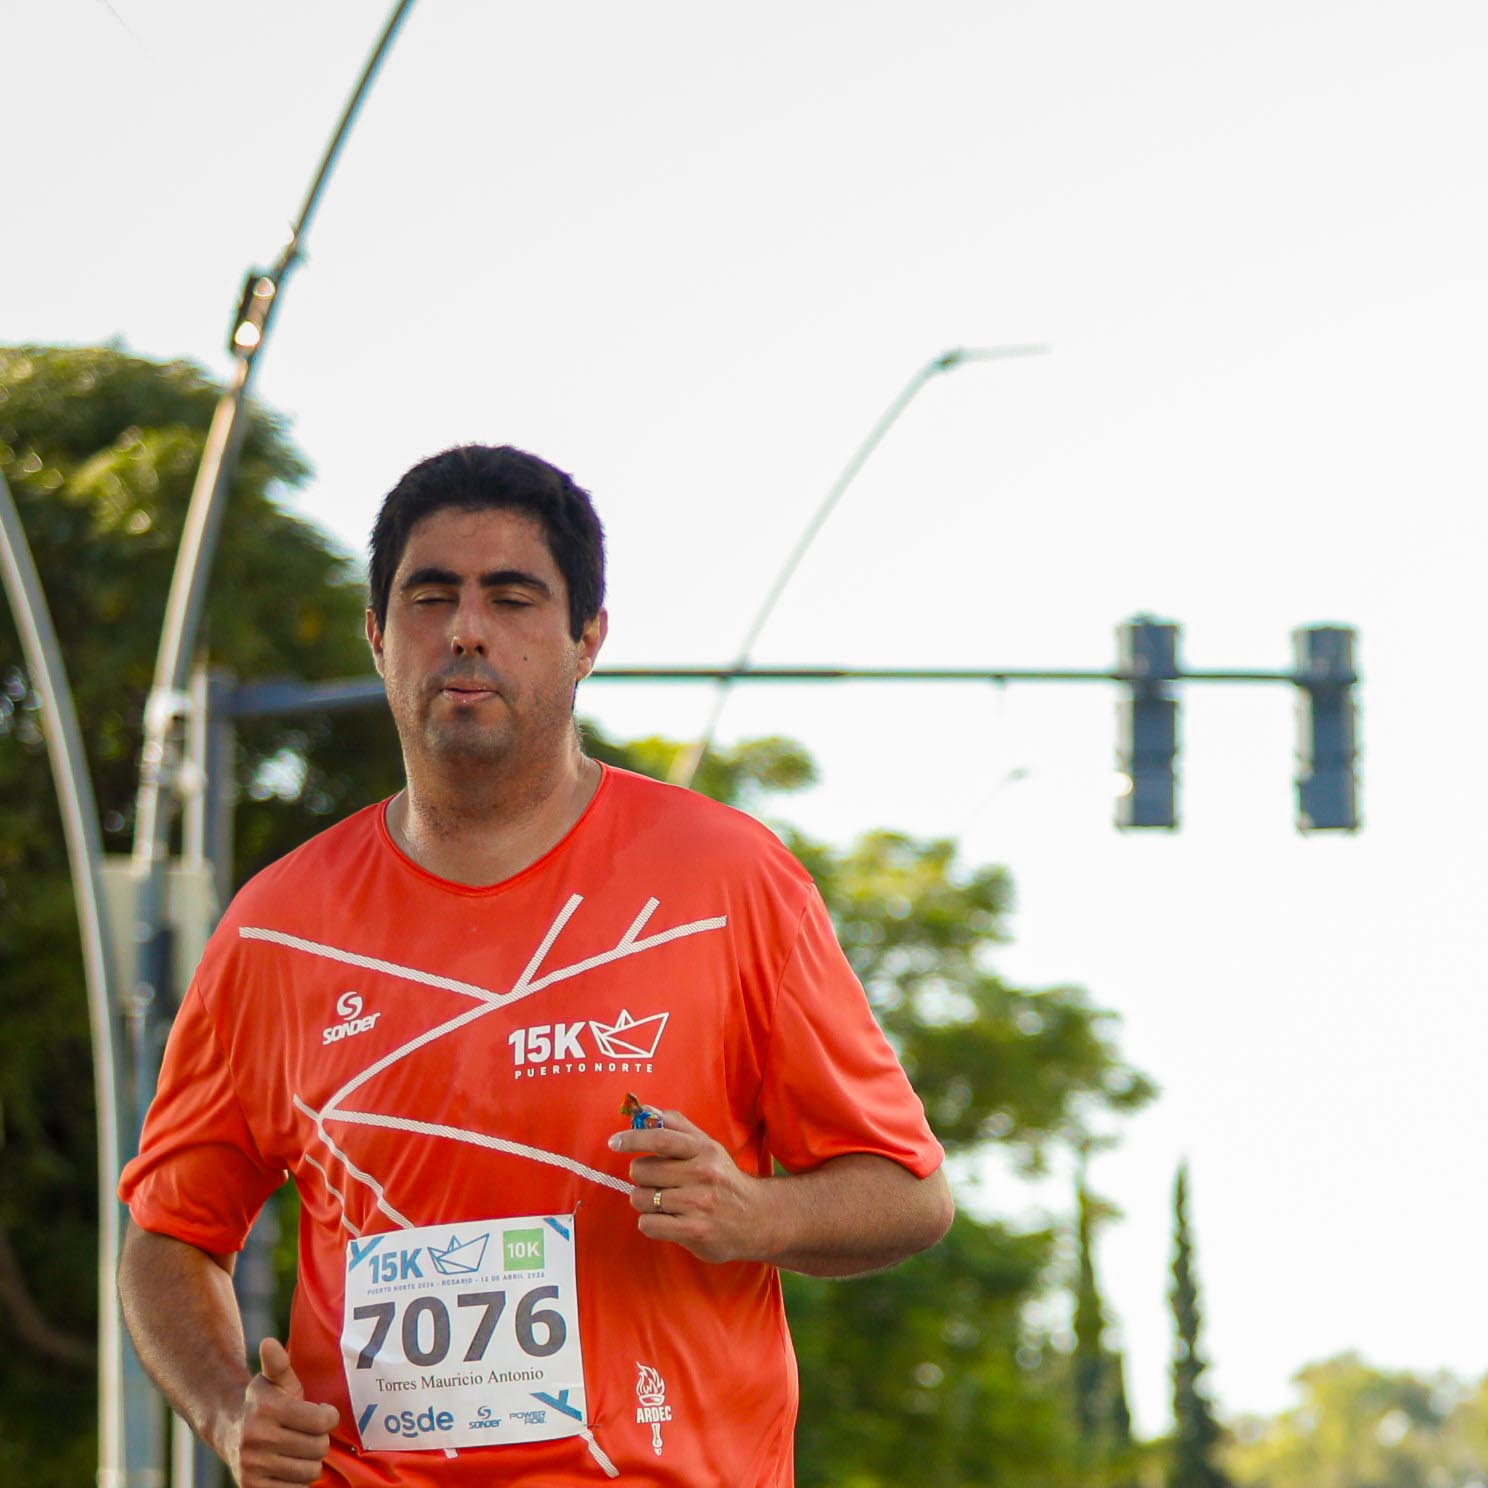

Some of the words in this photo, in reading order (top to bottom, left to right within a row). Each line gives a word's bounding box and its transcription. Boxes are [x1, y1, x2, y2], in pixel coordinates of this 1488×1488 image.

[508, 1021, 586, 1066] 15K
[514, 1064, 586, 1080] PUERTO
[595, 1063, 653, 1073] NORTE
[508, 1241, 541, 1259] 10K
[369, 1248, 424, 1284] 15K
[367, 1287, 392, 1295] PUERTO
[353, 1285, 567, 1369] 7076
[376, 1378, 417, 1392] Torres
[422, 1371, 483, 1389] Mauricio
[487, 1366, 544, 1384] Antonio
[384, 1406, 455, 1435] osde
[636, 1405, 672, 1424] ARDEC
